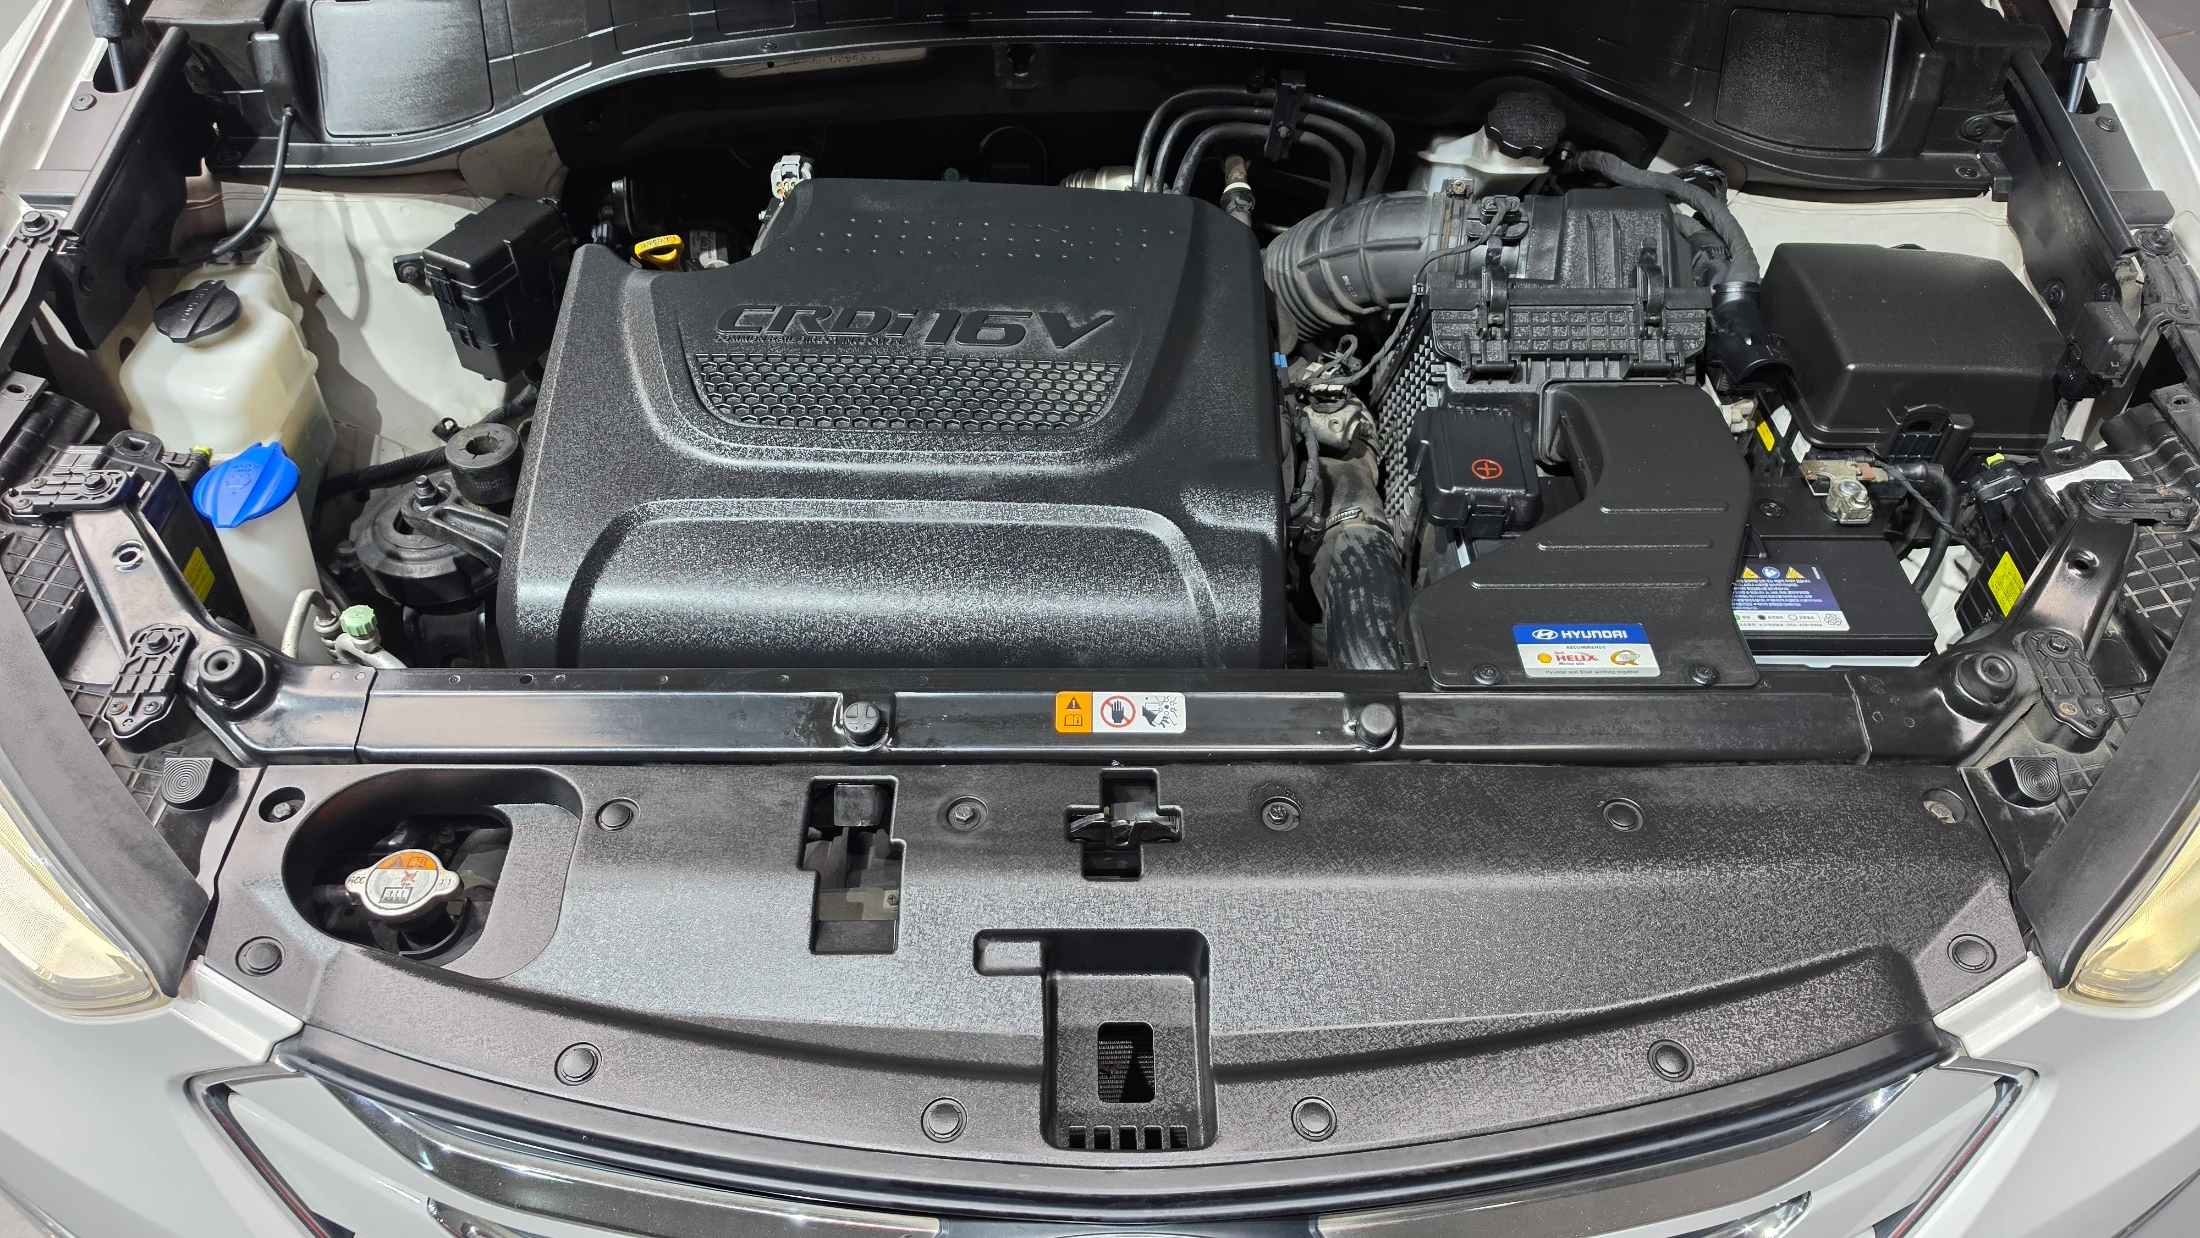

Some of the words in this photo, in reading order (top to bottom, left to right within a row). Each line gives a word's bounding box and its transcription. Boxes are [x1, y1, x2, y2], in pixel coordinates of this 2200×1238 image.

[923, 310, 1116, 349] 16V
[1561, 630, 1628, 639] HYUNDAI
[1555, 654, 1598, 662] HELIX
